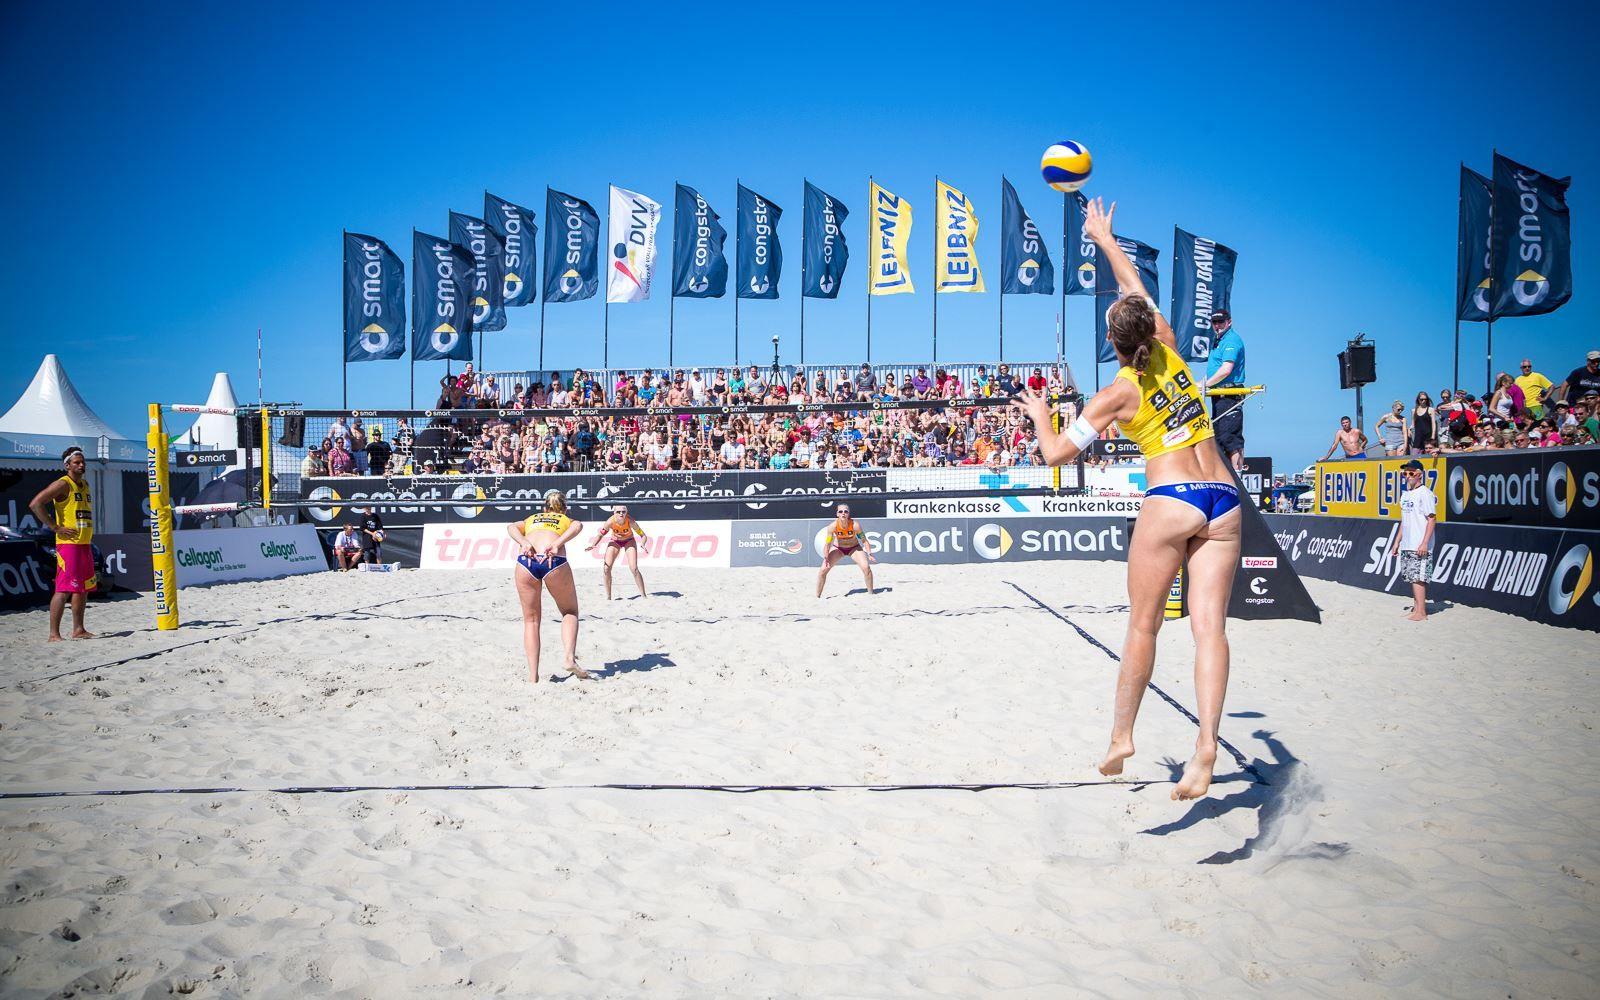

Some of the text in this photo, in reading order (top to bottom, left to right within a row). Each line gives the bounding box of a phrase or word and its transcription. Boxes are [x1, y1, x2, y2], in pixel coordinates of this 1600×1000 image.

[629, 198, 648, 246] DVV
[501, 204, 520, 268] smart
[942, 190, 977, 287] LEIBNIZ
[362, 242, 382, 318] smart
[433, 242, 454, 318] smart
[1194, 236, 1216, 330] CAMP DAVID
[581, 408, 599, 416] smart
[805, 403, 823, 411] smart
[1192, 416, 1210, 432] sky
[14, 440, 45, 456] Lounge
[199, 453, 226, 462] smart
[1118, 443, 1140, 451] sma
[148, 447, 160, 493] LEIBNIZ
[1319, 466, 1367, 512] LEIBNIZ
[1474, 467, 1539, 506] smart
[893, 500, 1001, 514] Krankenkasse
[1042, 500, 1140, 513] Krankenkass
[151, 509, 165, 554] LEIBNIZ
[738, 540, 787, 548] beach tour
[749, 532, 776, 540] smart
[866, 526, 963, 553] smart
[1021, 526, 1123, 551] smart
[176, 547, 223, 569] Cellagon
[260, 541, 297, 560] Cellagon
[1307, 534, 1352, 564] congstar
[1245, 558, 1274, 567] tipico
[1453, 546, 1548, 597] CAMP DAVID
[154, 570, 170, 615] LEIBNIZ
[1245, 597, 1275, 605] congstar
